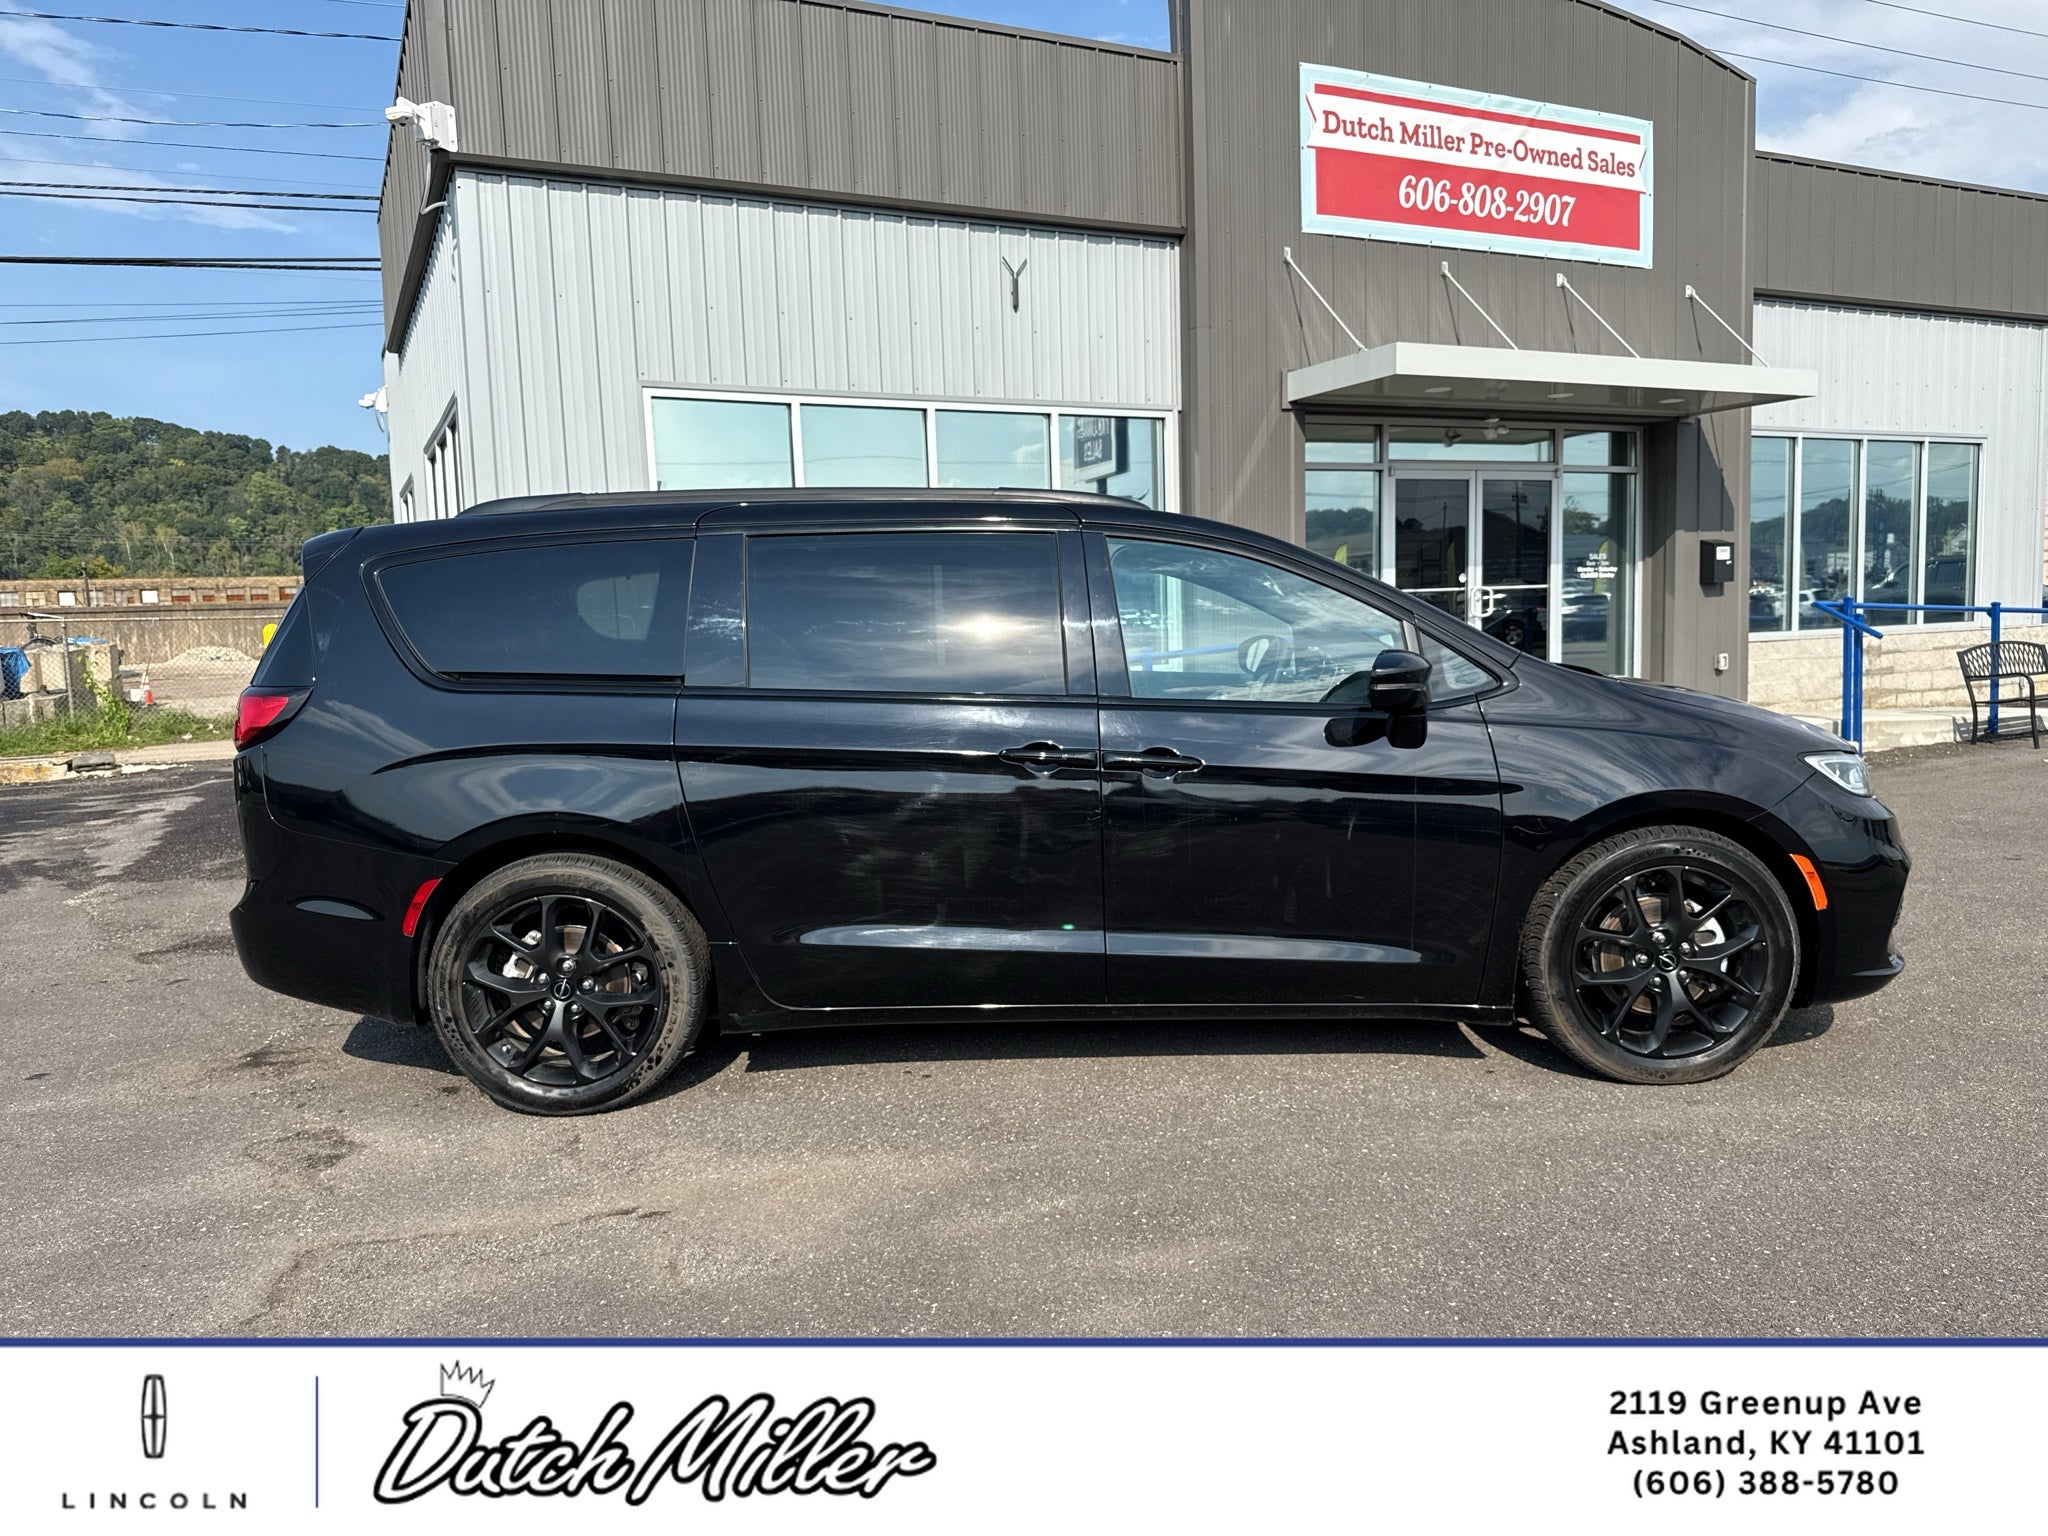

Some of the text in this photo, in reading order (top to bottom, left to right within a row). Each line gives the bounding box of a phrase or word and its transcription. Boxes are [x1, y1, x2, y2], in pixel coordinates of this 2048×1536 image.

[1322, 110, 1636, 178] Dutch Miller Pre-Owned Sales
[1398, 174, 1577, 228] 606-808-2907
